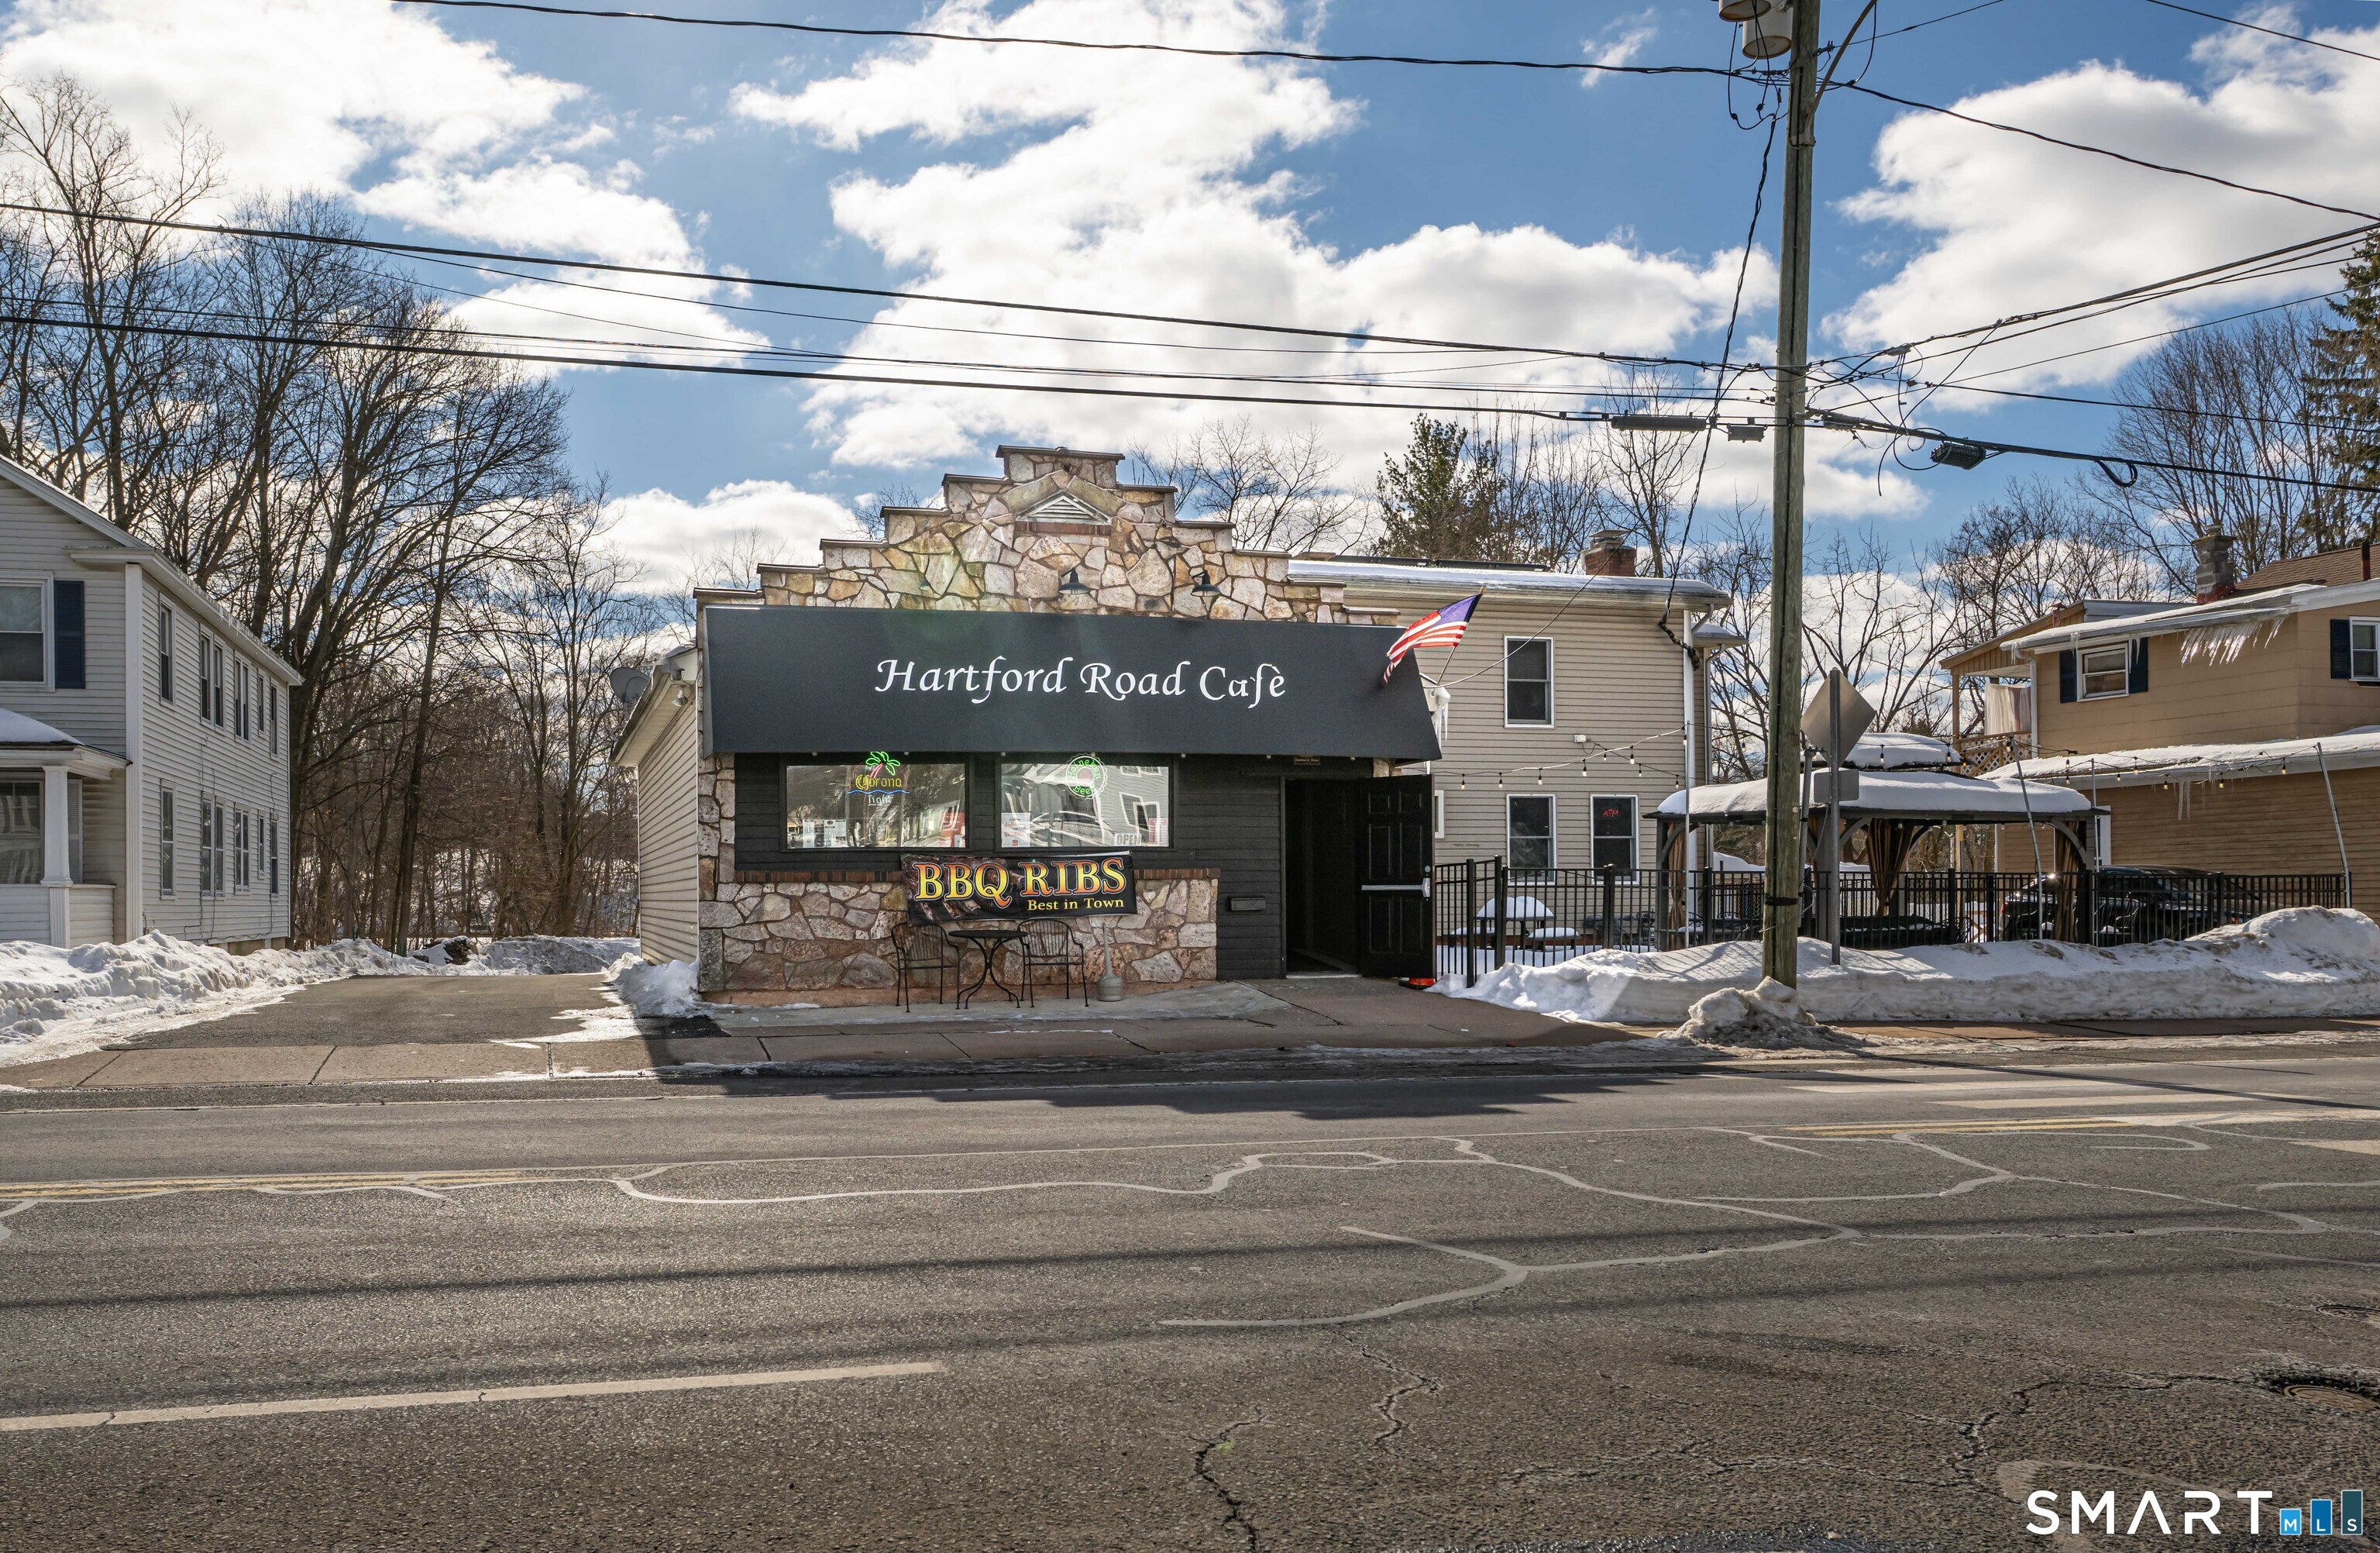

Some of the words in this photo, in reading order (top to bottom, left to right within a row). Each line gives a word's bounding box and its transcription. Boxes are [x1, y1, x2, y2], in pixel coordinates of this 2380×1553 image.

[875, 655, 1074, 704] Hartford
[1079, 660, 1191, 701] Road
[1067, 759, 1101, 780] Heineken
[855, 774, 903, 790] Corona
[868, 794, 893, 806] Light
[1603, 808, 1619, 818] ATM
[1116, 834, 1141, 845] OPEN
[913, 862, 1012, 909] BBQ
[1018, 857, 1127, 897] RIBS
[1027, 900, 1058, 911] Best
[1064, 900, 1078, 910] in
[1085, 897, 1124, 908] Town
